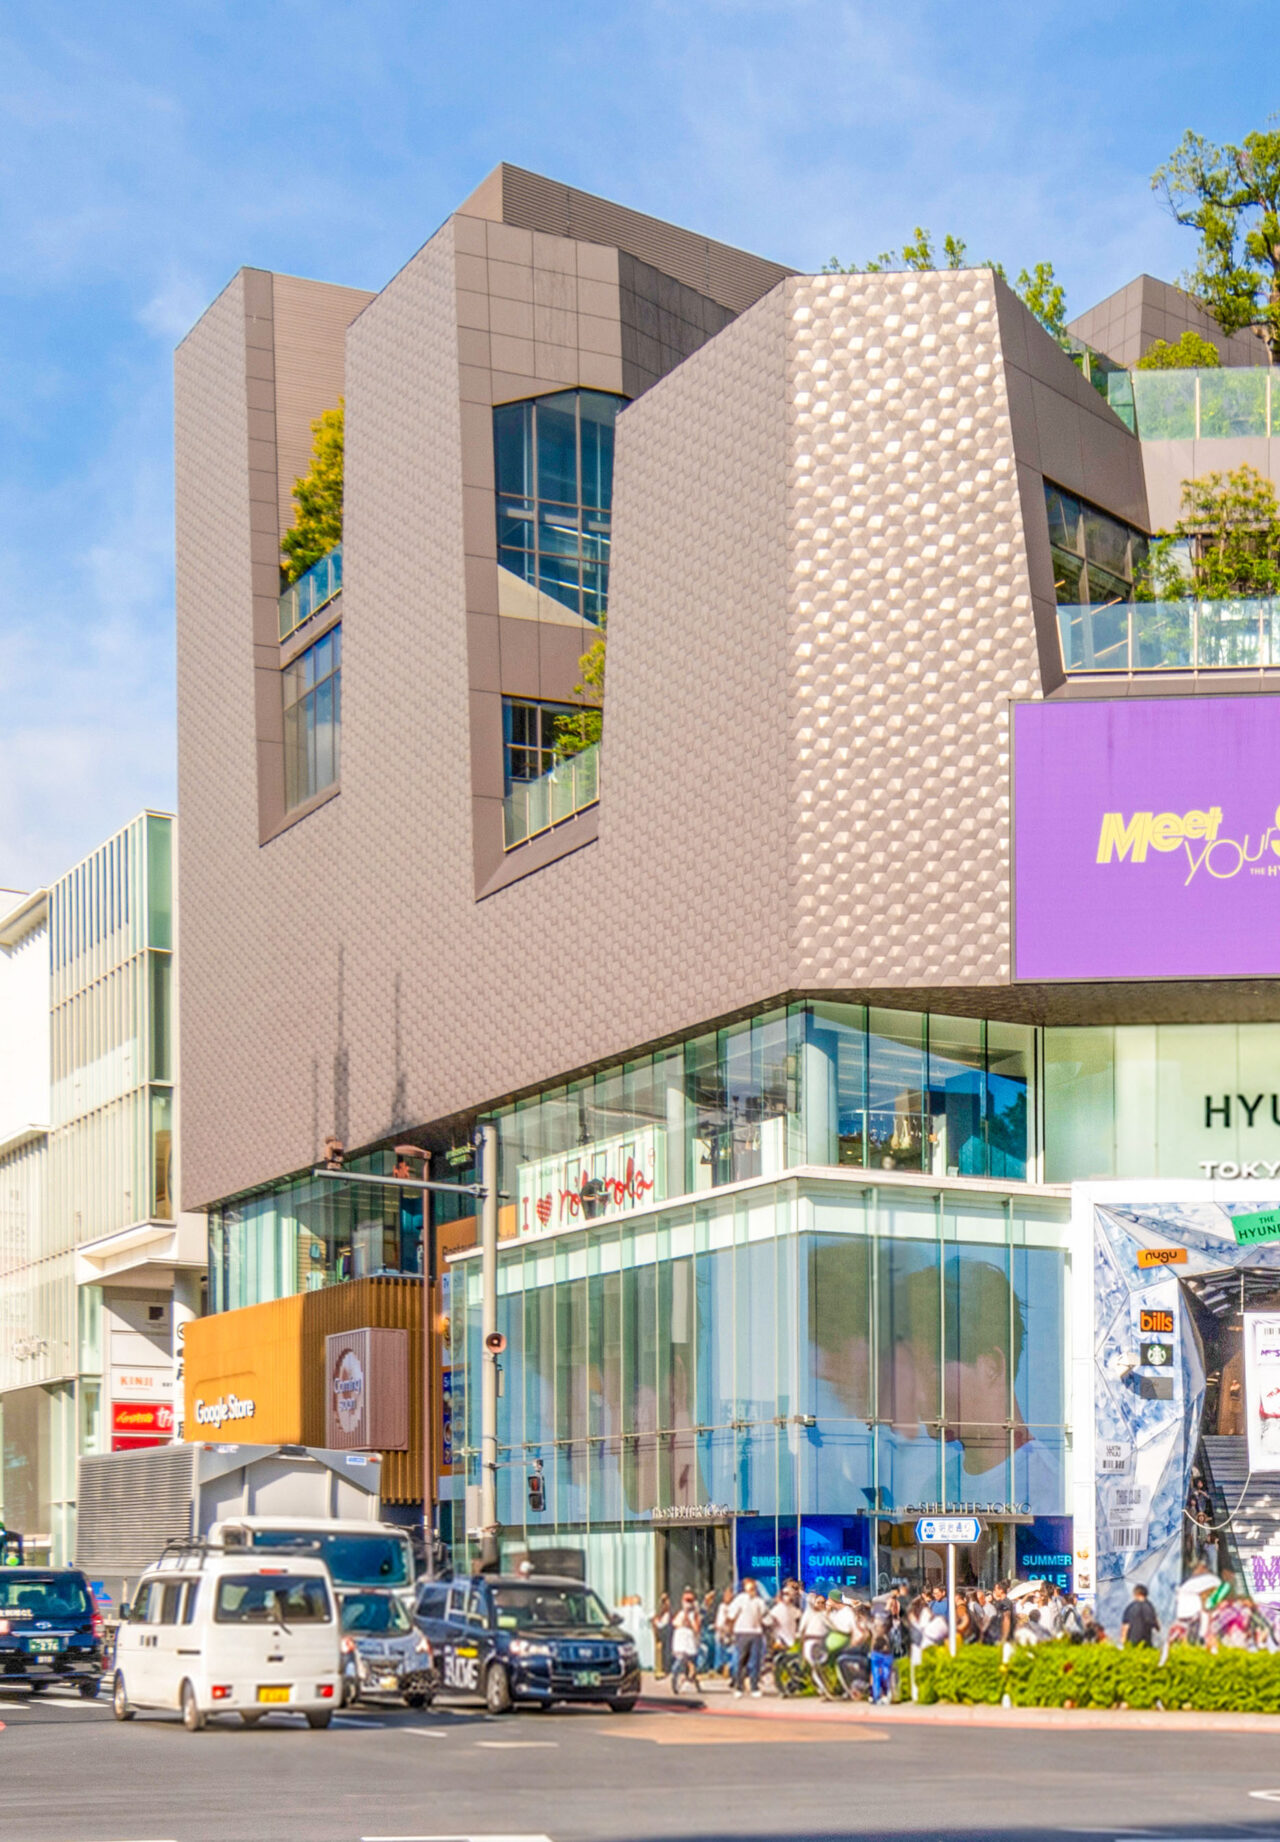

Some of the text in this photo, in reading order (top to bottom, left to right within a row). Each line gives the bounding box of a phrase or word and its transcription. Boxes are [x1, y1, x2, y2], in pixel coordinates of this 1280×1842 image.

[1096, 806, 1223, 864] Meet
[1184, 826, 1277, 887] your
[1250, 867, 1266, 876] THE
[1258, 1215, 1275, 1224] THE
[1145, 1250, 1177, 1263] nugu
[1140, 1311, 1173, 1331] bills
[196, 1398, 228, 1428] Google
[227, 1394, 255, 1419] Store
[808, 1555, 863, 1567] SUMMER
[1022, 1555, 1072, 1566] SUMMER
